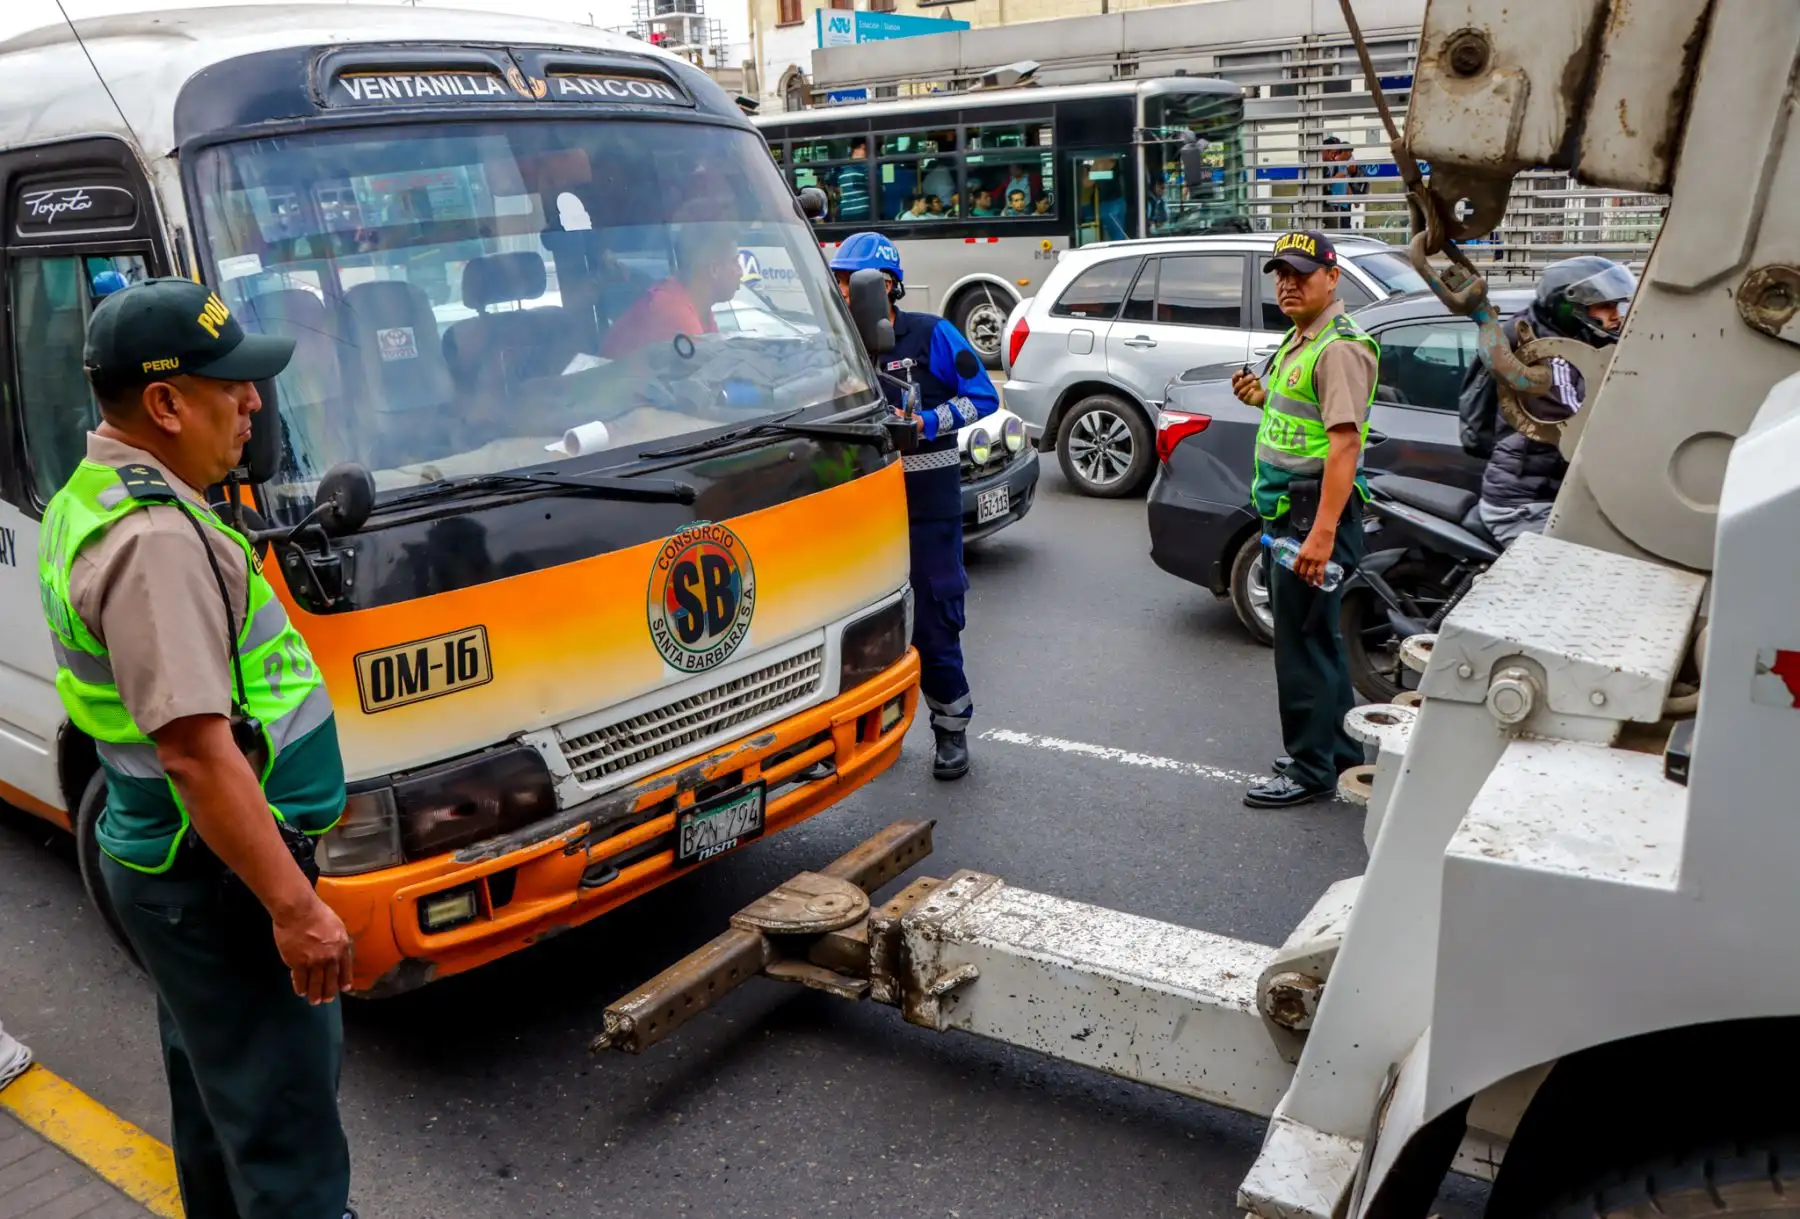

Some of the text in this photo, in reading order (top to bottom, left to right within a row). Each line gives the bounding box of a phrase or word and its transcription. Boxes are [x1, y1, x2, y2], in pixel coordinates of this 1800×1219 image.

[829, 17, 851, 33] ATU
[340, 76, 506, 100] VENTANILLA
[560, 78, 677, 101] ANCON
[25, 189, 93, 225] Toyota
[876, 245, 899, 261] ATU
[1273, 233, 1316, 257] POLICIA
[142, 357, 179, 374] PERU
[658, 527, 734, 570] CONSORCIO
[673, 554, 738, 644] SB
[653, 582, 753, 669] SANTA BARBARA S.A.
[371, 635, 478, 703] OM-16
